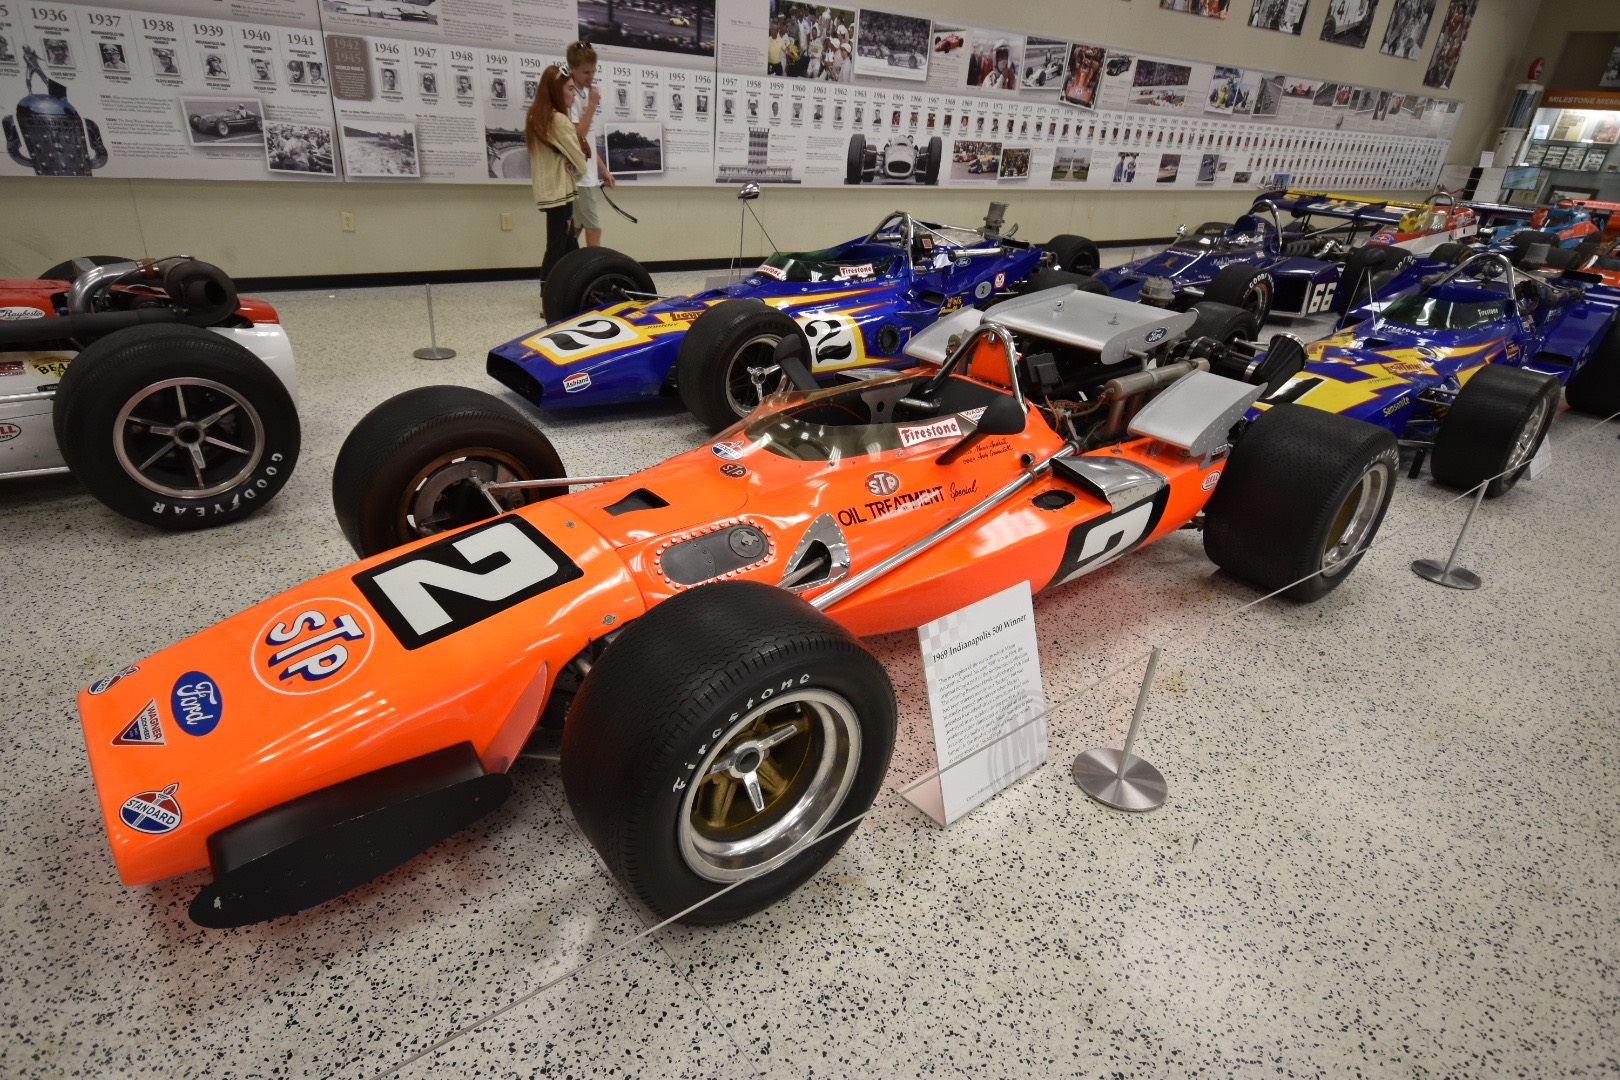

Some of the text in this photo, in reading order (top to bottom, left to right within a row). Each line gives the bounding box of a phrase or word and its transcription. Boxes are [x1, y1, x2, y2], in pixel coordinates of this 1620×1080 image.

[30, 8, 67, 22] 1936
[88, 13, 121, 27] 1937
[142, 18, 175, 32] 1938
[193, 24, 224, 37] 1939
[242, 29, 271, 42] 1940
[288, 34, 314, 46] 1941
[334, 39, 359, 51] 1942
[374, 43, 400, 54] 1946
[335, 52, 362, 63] 1945
[413, 47, 437, 58] 1947
[450, 50, 473, 62] 1948
[486, 54, 508, 65] 1949
[520, 57, 541, 68] 1950
[613, 67, 631, 77] 1953
[641, 69, 659, 79] 1954
[668, 72, 686, 82] 1955
[694, 75, 712, 84] 1956
[722, 78, 738, 86] 1957
[746, 80, 762, 88] 1958
[770, 82, 784, 90] 1959
[792, 84, 806, 92] 1960
[813, 86, 826, 94] 1961
[1548, 96, 1596, 104] MILESTONE
[841, 266, 872, 276] Firestone
[1307, 282, 1337, 314] 66
[539, 319, 621, 350] 2
[1148, 329, 1164, 342] Ford
[805, 320, 852, 364] 2
[38, 362, 71, 375] BEA
[566, 376, 589, 389] Ashland
[1383, 396, 1410, 417] Samsonite
[902, 423, 957, 443] Firestone
[723, 464, 744, 475] STP
[152, 452, 283, 517] GOODYEAR
[867, 474, 899, 494] STP
[837, 479, 978, 526] OIL TREATMENT Special
[372, 522, 558, 636] 2
[932, 614, 1027, 663] 1969 Indianapolis 500 Winner
[265, 610, 365, 682] STP
[176, 681, 217, 725] Ford
[147, 706, 162, 740] WAGNER
[672, 674, 811, 792] Firestone
[126, 799, 175, 825] STANDARD
